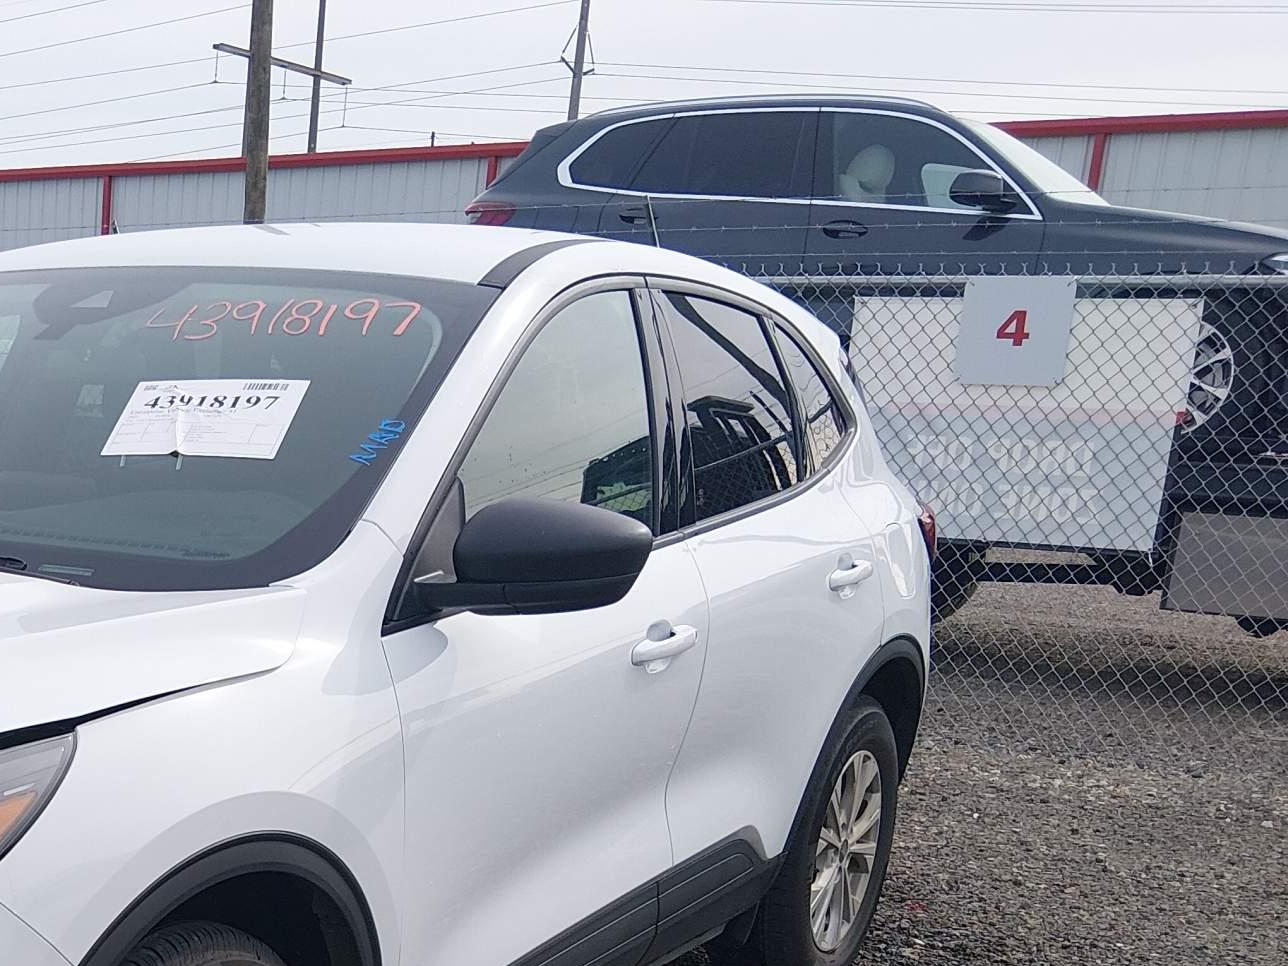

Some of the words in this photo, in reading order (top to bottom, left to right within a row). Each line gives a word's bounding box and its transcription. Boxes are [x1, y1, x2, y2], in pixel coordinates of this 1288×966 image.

[145, 297, 422, 342] 43918197
[996, 309, 1030, 346] 4
[144, 394, 281, 410] 43918197
